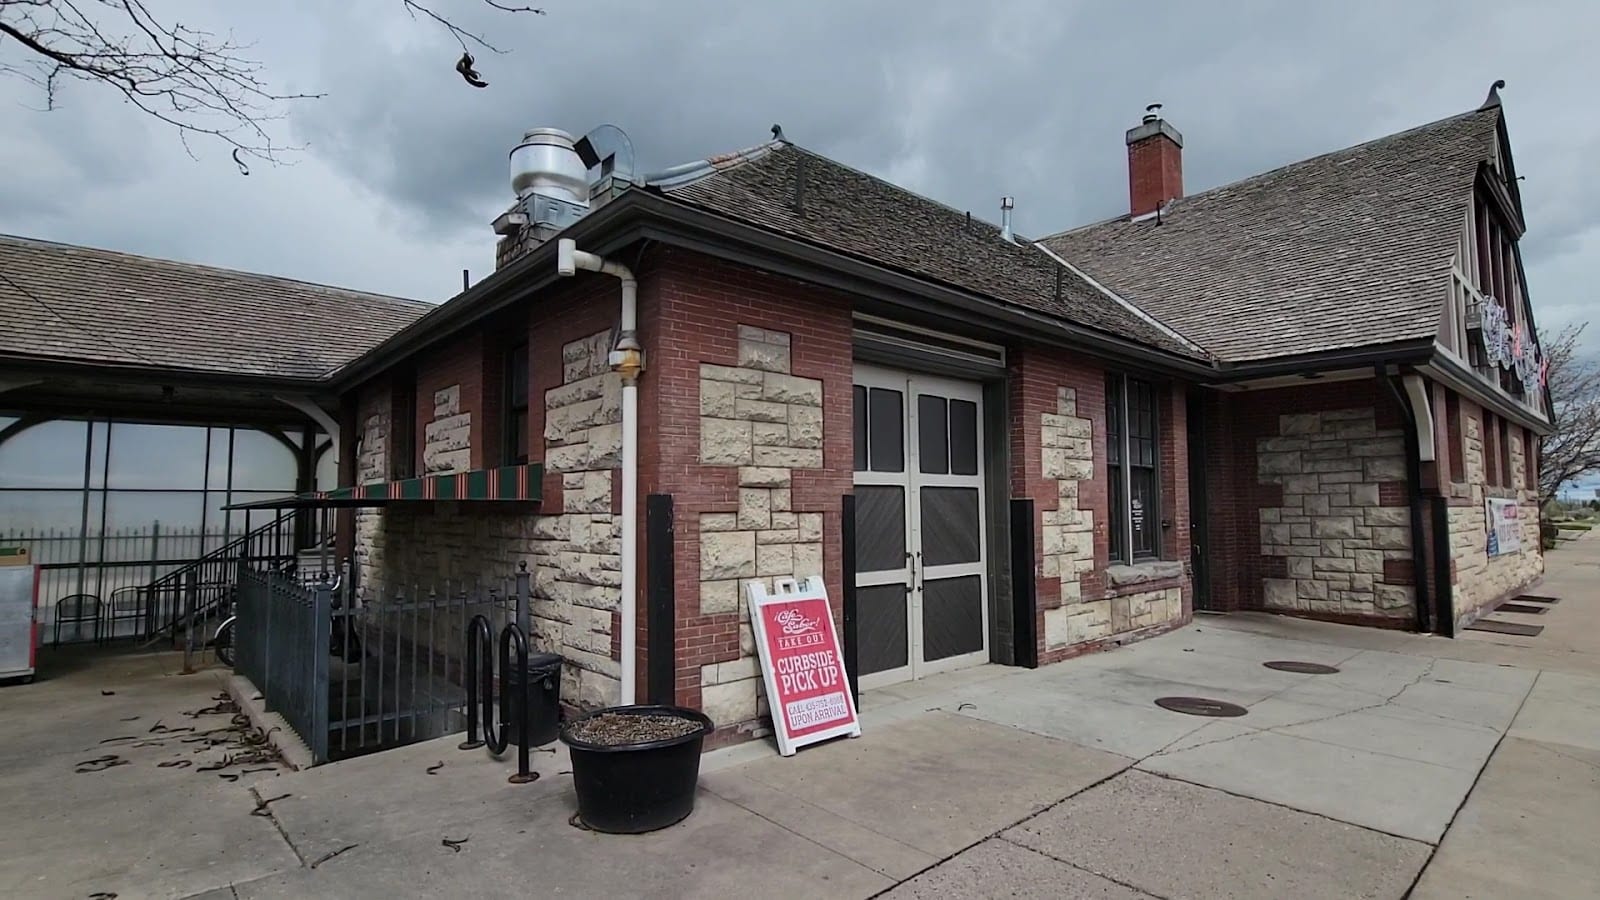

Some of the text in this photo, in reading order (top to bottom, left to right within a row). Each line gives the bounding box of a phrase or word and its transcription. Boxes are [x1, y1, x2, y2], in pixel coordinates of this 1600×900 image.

[778, 633, 825, 649] TAKE OUT
[777, 650, 835, 674] CURBSIDE
[781, 666, 838, 695] PICK UP
[788, 704, 805, 715] CALL
[790, 705, 846, 727] UPON ARRIVAL
